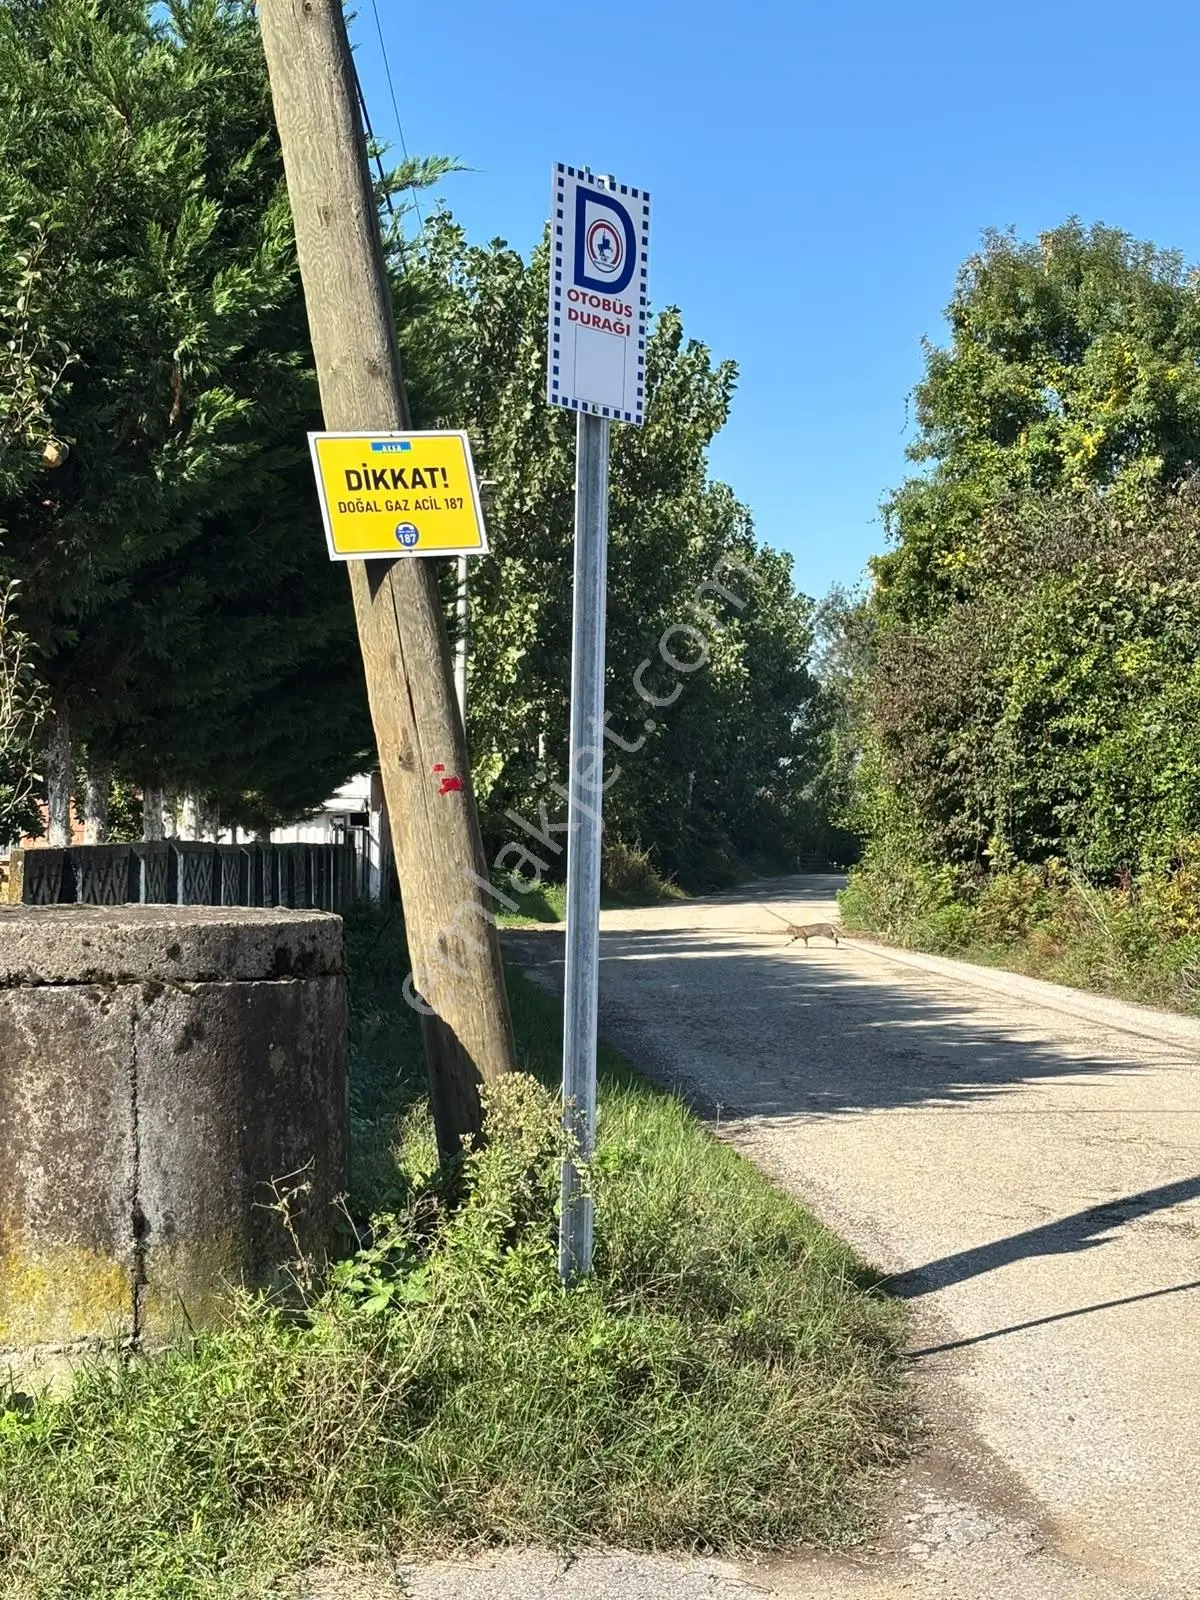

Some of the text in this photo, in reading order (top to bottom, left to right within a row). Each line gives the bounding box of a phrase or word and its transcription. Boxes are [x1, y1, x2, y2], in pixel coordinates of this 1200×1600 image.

[574, 185, 637, 295] D
[567, 288, 633, 318] OTOBÜS
[567, 307, 631, 337] DURAĞI
[345, 463, 449, 491] DİKKAT!
[338, 496, 463, 514] DOĞAL GAZ ACİL 187
[399, 533, 417, 544] 187
